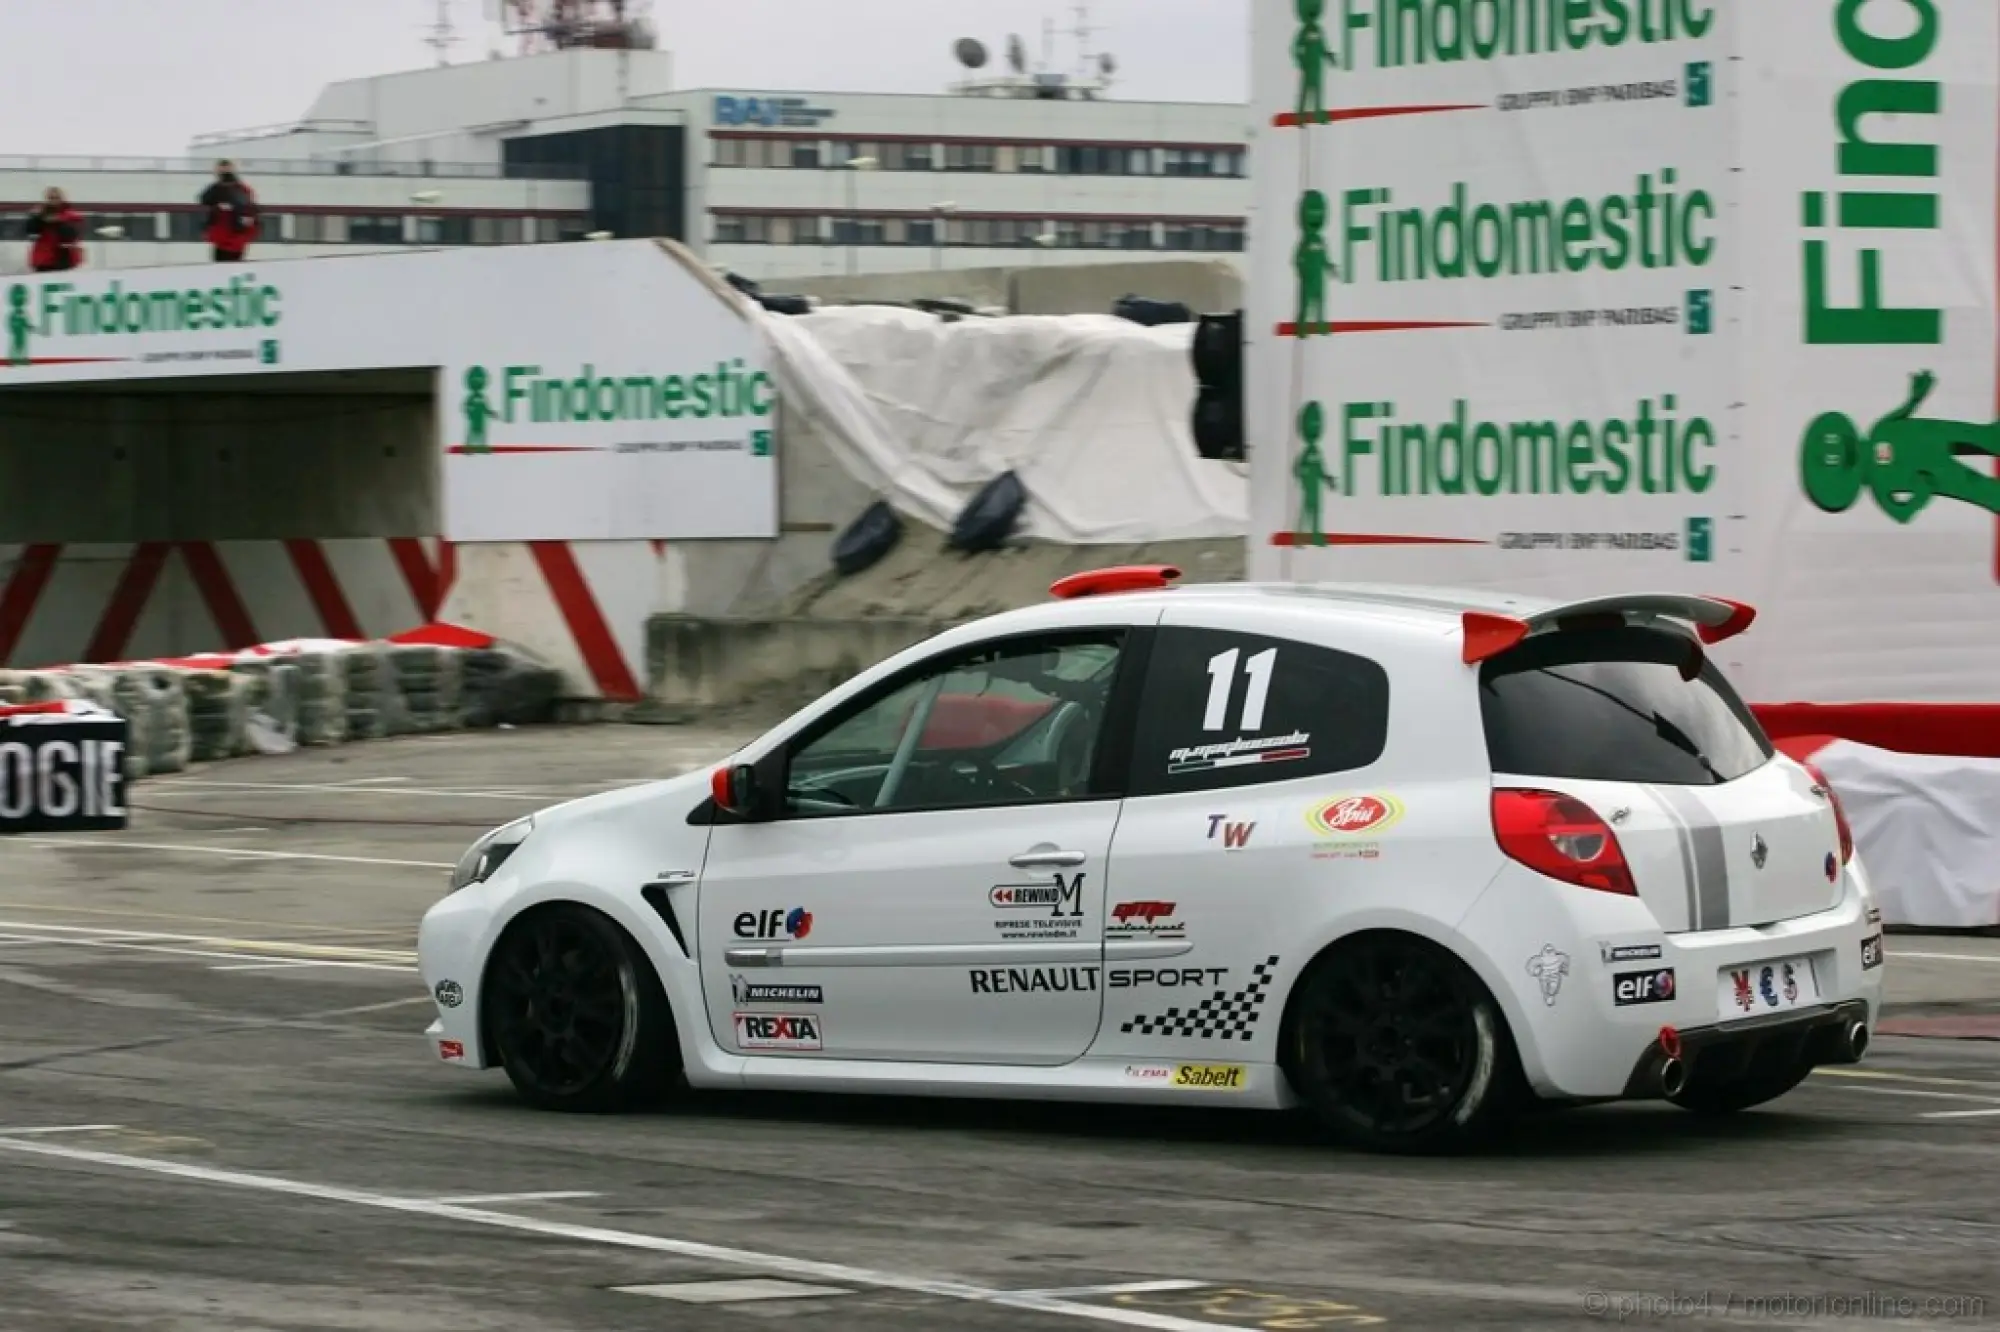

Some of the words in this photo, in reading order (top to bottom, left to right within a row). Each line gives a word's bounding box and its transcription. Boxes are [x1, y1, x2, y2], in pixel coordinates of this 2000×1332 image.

[1344, 167, 1715, 284] Findomestic
[40, 273, 280, 336] Findomestic
[503, 357, 774, 424] Findomestic
[1344, 393, 1715, 496] Findomestic
[1203, 647, 1278, 731] 11
[1014, 888, 1059, 904] REWIND
[1051, 872, 1087, 917] M
[733, 909, 785, 938] elf
[750, 987, 820, 1000] MICHELIN
[968, 966, 1101, 993] RENAULT
[1108, 967, 1229, 988] SPORT
[1616, 974, 1655, 1001] elf
[745, 1016, 818, 1040] REXTA
[1176, 1065, 1239, 1087] Sabelt
